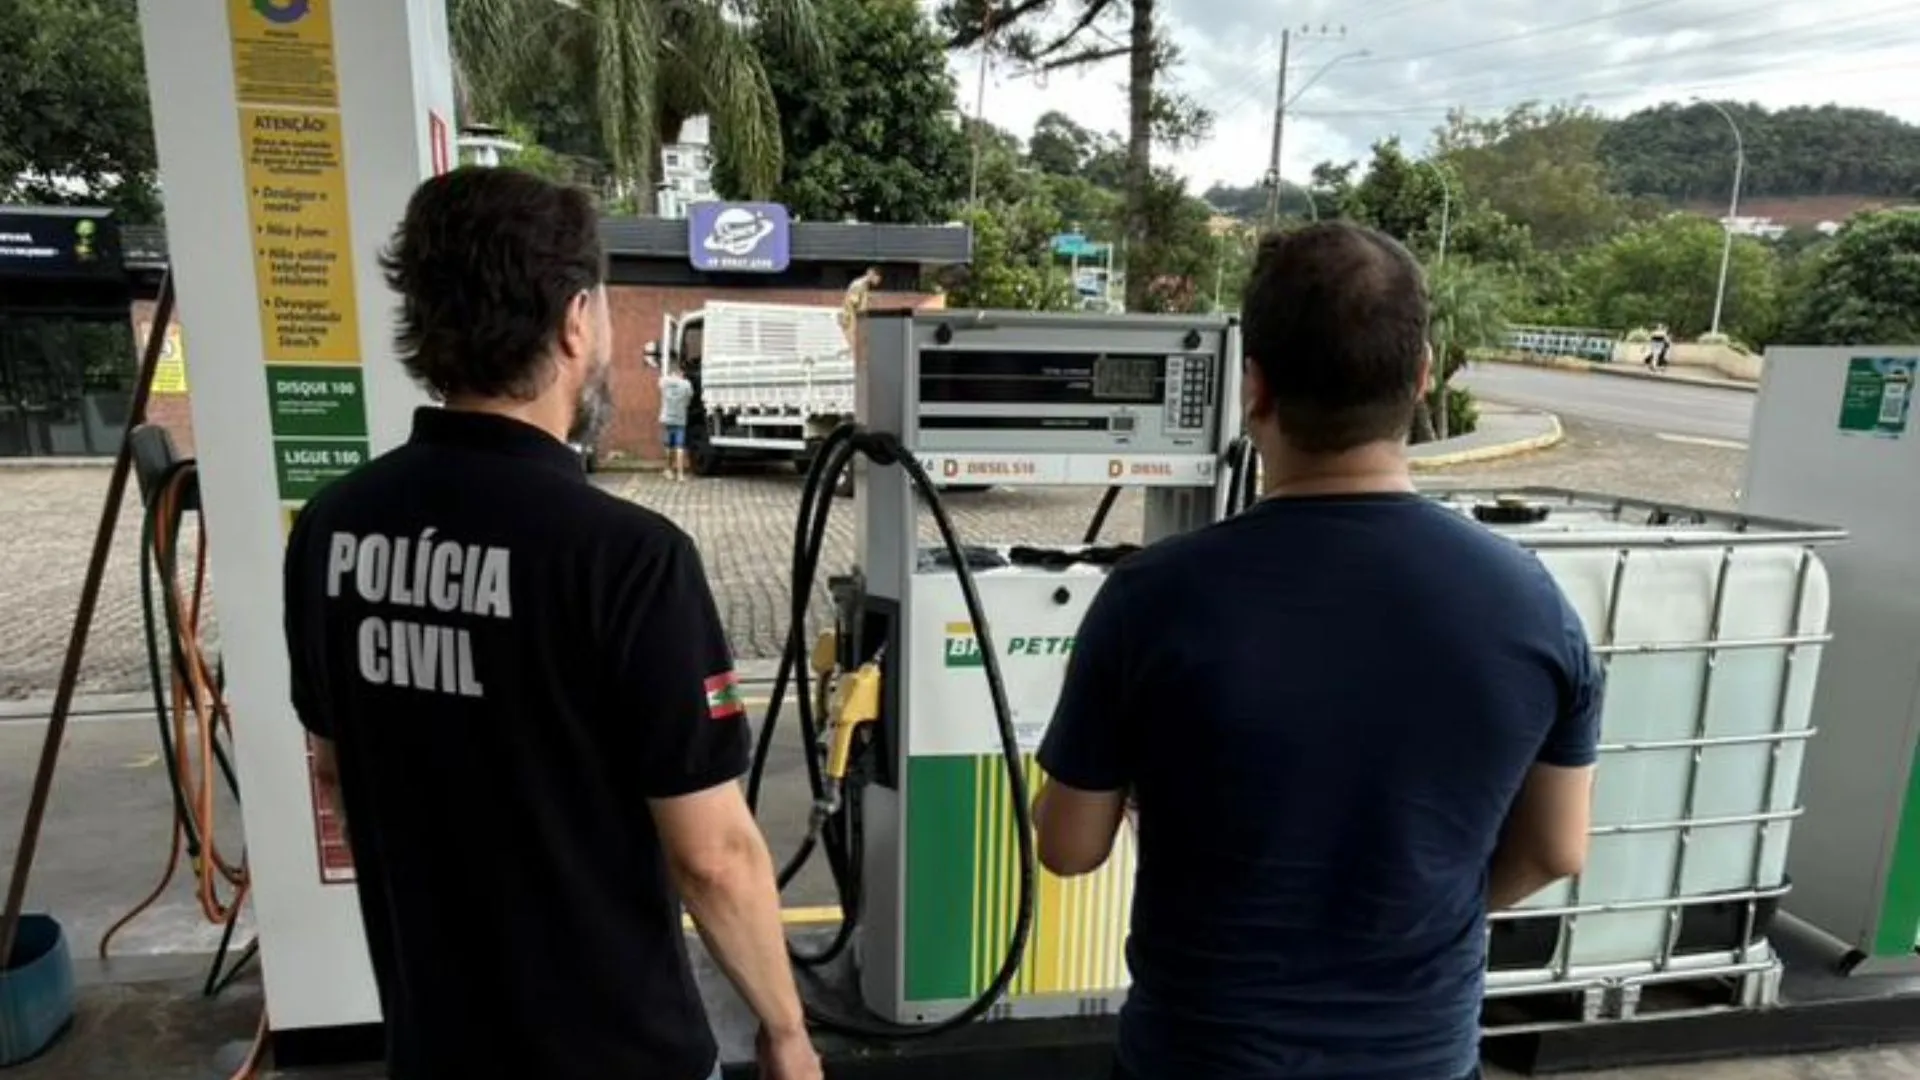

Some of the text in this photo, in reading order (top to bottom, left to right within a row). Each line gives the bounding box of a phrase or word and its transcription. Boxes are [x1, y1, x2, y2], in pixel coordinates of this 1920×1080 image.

[276, 381, 328, 396] DISQUE
[284, 449, 329, 464] LIGUE
[967, 461, 1009, 474] DIESEL
[1130, 462, 1173, 476] DIESEL
[327, 526, 512, 618] POLÍCIA
[358, 616, 484, 697] CIVIL
